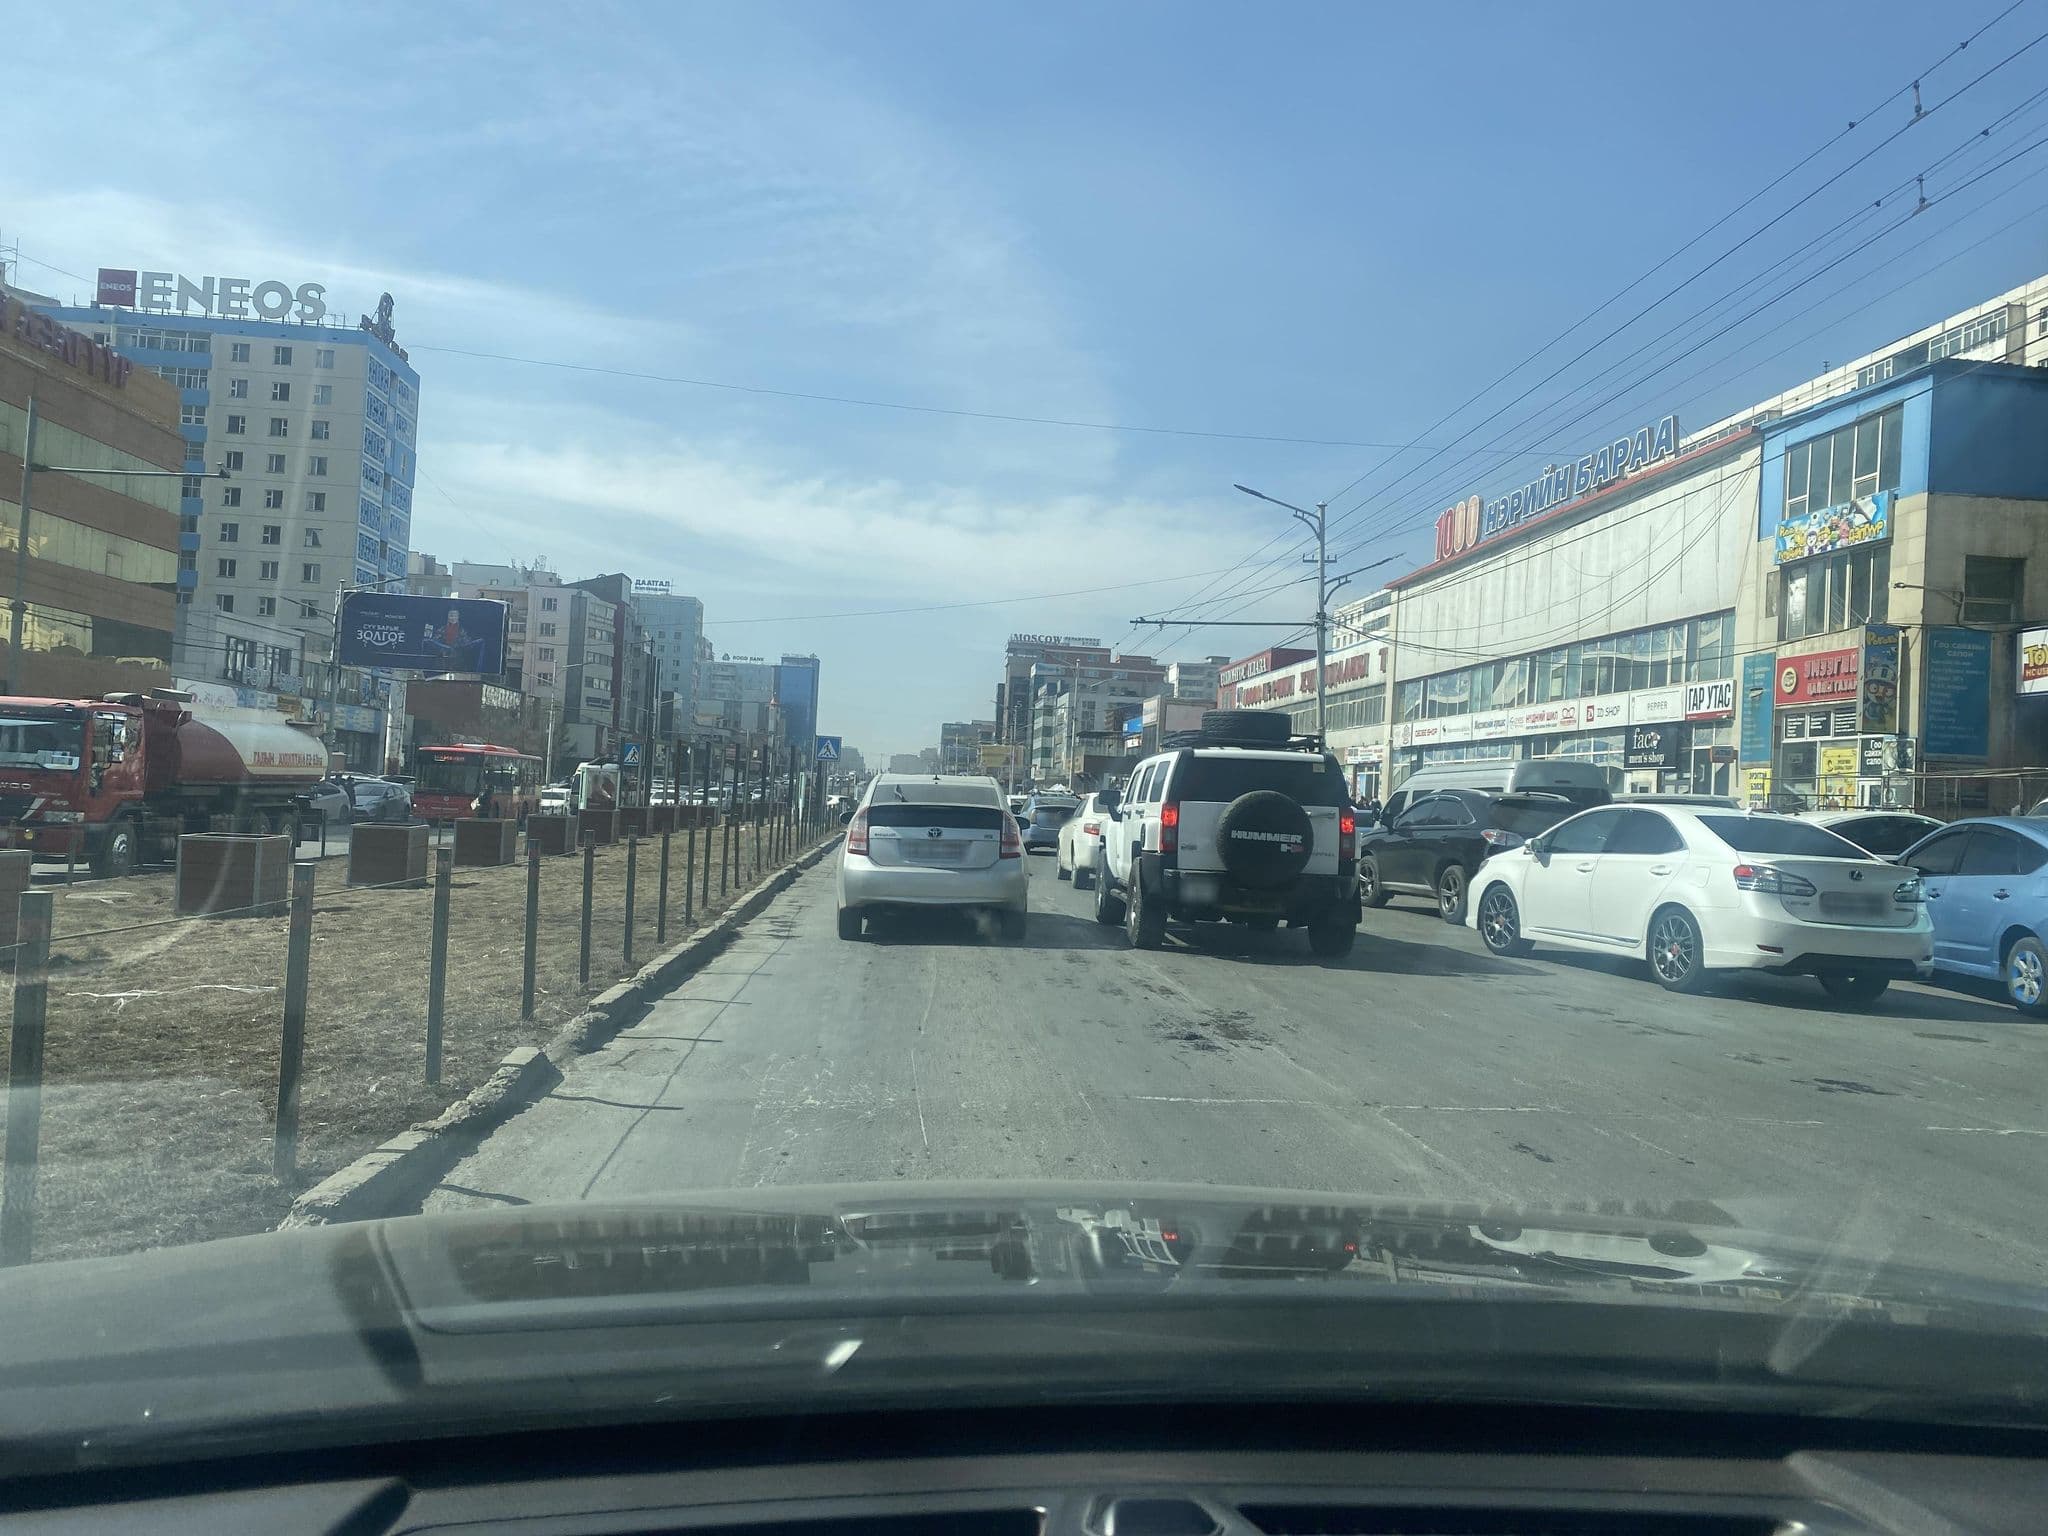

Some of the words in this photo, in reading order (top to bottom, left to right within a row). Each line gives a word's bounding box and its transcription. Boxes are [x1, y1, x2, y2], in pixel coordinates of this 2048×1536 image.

[100, 282, 132, 292] ENEOS
[139, 271, 327, 321] ENEOS
[1435, 495, 1482, 562] 1000
[1485, 463, 1573, 535] НЭРИЙН
[1575, 415, 1679, 495] БАРАА
[635, 579, 670, 587] ДААТГАЛ
[1013, 633, 1063, 644] MOSCOW
[1688, 687, 1704, 711] ГАР
[1706, 683, 1731, 709] УТАС
[1605, 705, 1621, 717] SHOP
[1647, 701, 1668, 711] PEPPER
[1648, 751, 1664, 765] shop
[1231, 829, 1302, 844] HUMMER
